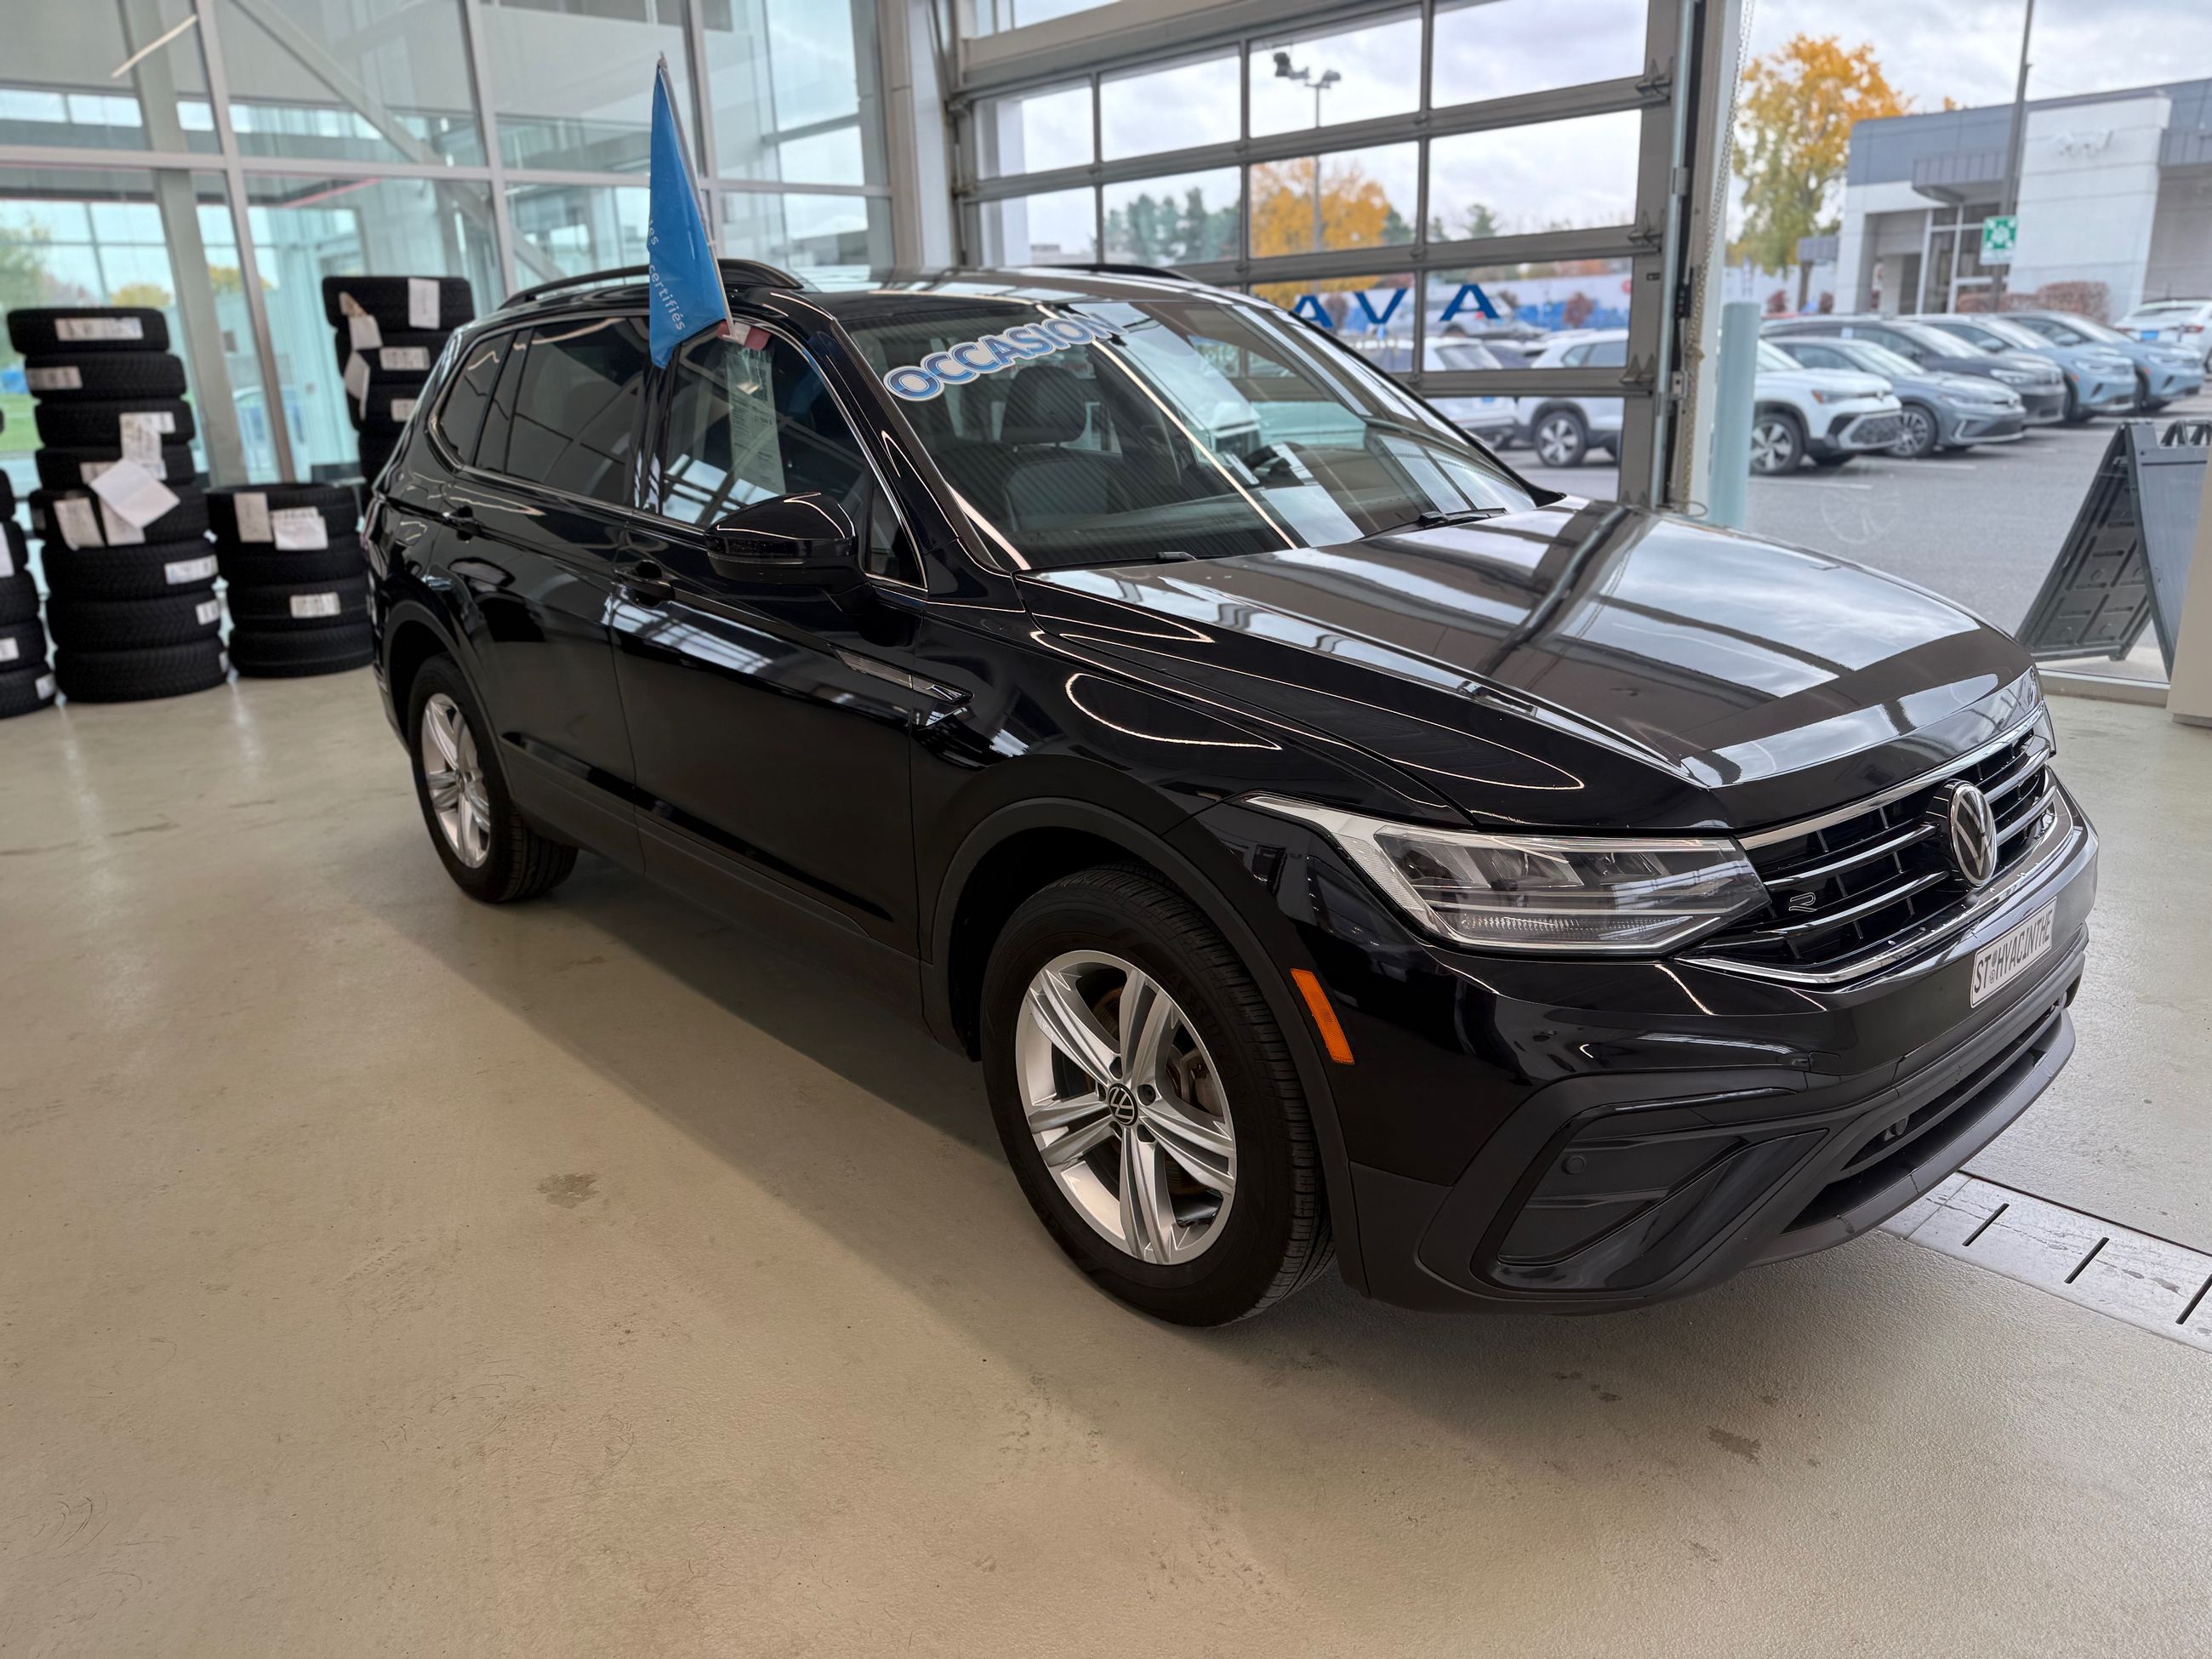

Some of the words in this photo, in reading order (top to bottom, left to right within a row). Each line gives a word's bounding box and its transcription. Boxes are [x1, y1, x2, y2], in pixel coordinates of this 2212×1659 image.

[648, 265, 686, 331] certifiés
[887, 315, 1123, 397] OCCASION
[1974, 954, 1992, 994] ST
[1996, 909, 2052, 980] HYACINTHE
